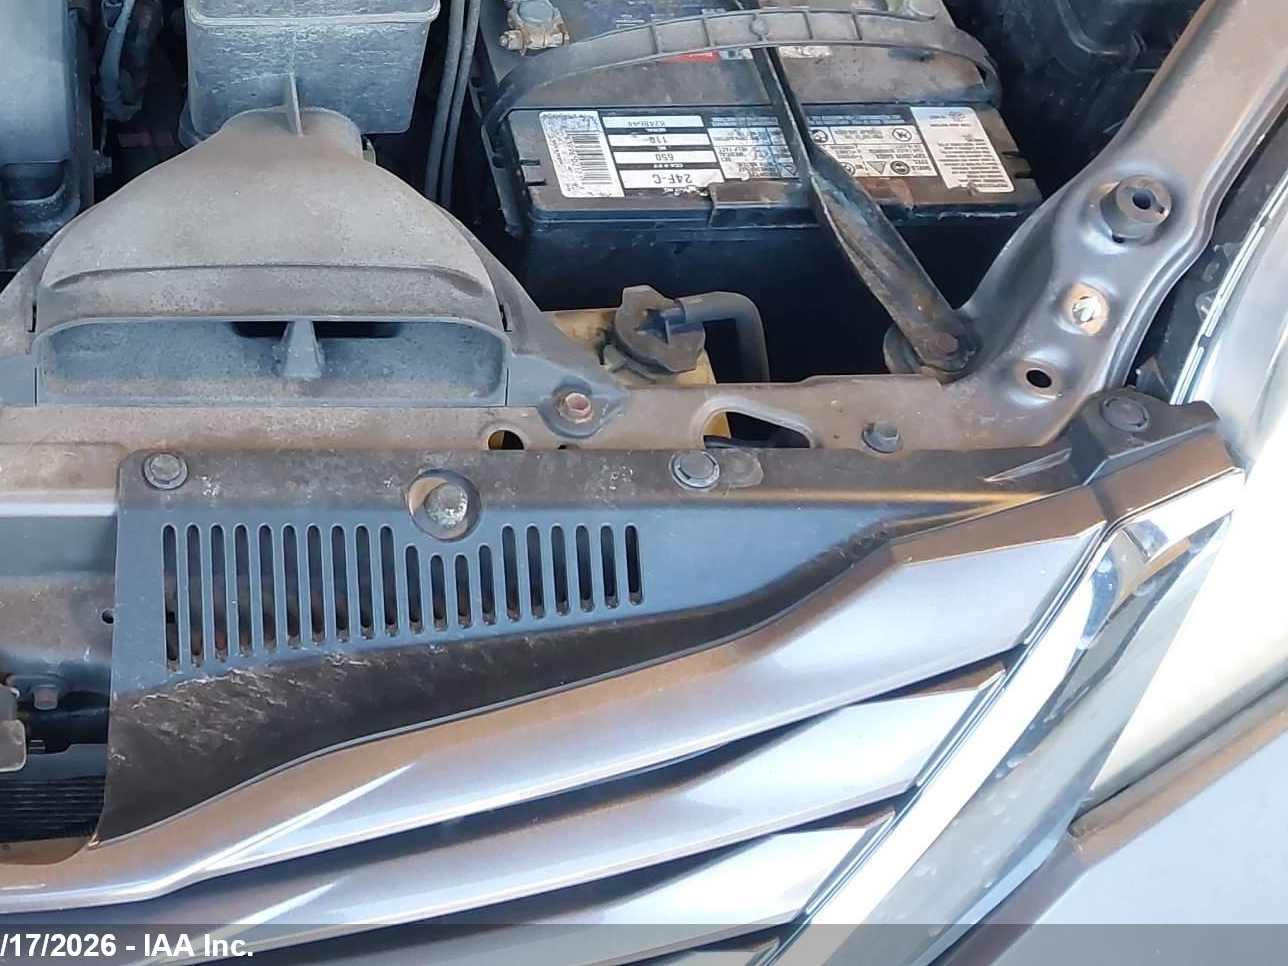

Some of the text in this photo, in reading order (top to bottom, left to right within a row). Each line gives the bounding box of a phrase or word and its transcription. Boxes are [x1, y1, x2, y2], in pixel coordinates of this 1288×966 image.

[649, 136, 668, 144] 110
[655, 153, 674, 161] 650
[652, 173, 693, 184] 24F-C
